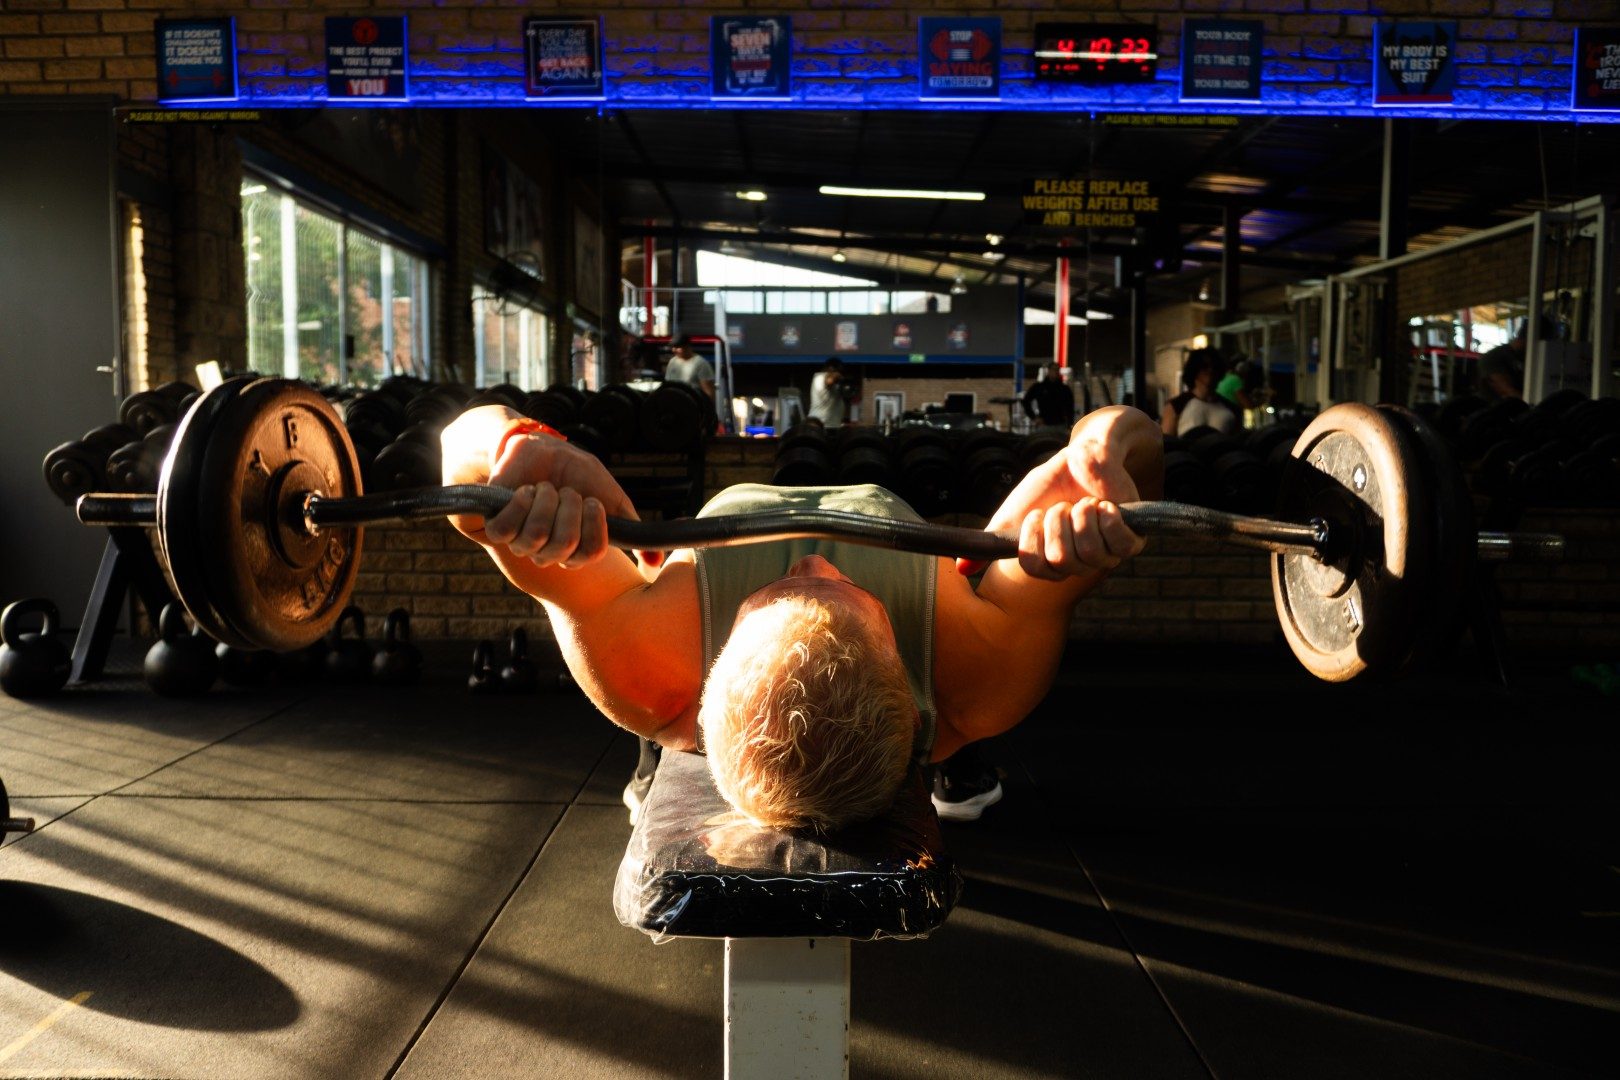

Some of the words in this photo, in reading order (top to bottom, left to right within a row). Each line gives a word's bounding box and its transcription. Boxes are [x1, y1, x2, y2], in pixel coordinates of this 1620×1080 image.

[329, 47, 344, 55] THE
[345, 47, 366, 55] BEST
[368, 47, 403, 55] PROJECT
[1383, 46, 1400, 57] MY
[1402, 46, 1433, 57] BODY
[1435, 46, 1447, 57] IS
[1390, 59, 1407, 70] MY
[1410, 59, 1439, 70] BEST
[1401, 72, 1428, 83] SUIT
[348, 79, 385, 95] YOU
[1034, 180, 1084, 194] PLEASE
[1089, 181, 1149, 195] REPLACE
[1023, 196, 1083, 210] WEIGHTS
[1087, 196, 1129, 210] AFTER
[1133, 197, 1159, 211] USE
[1043, 211, 1071, 226] AND
[1075, 213, 1136, 227] BENCHES
